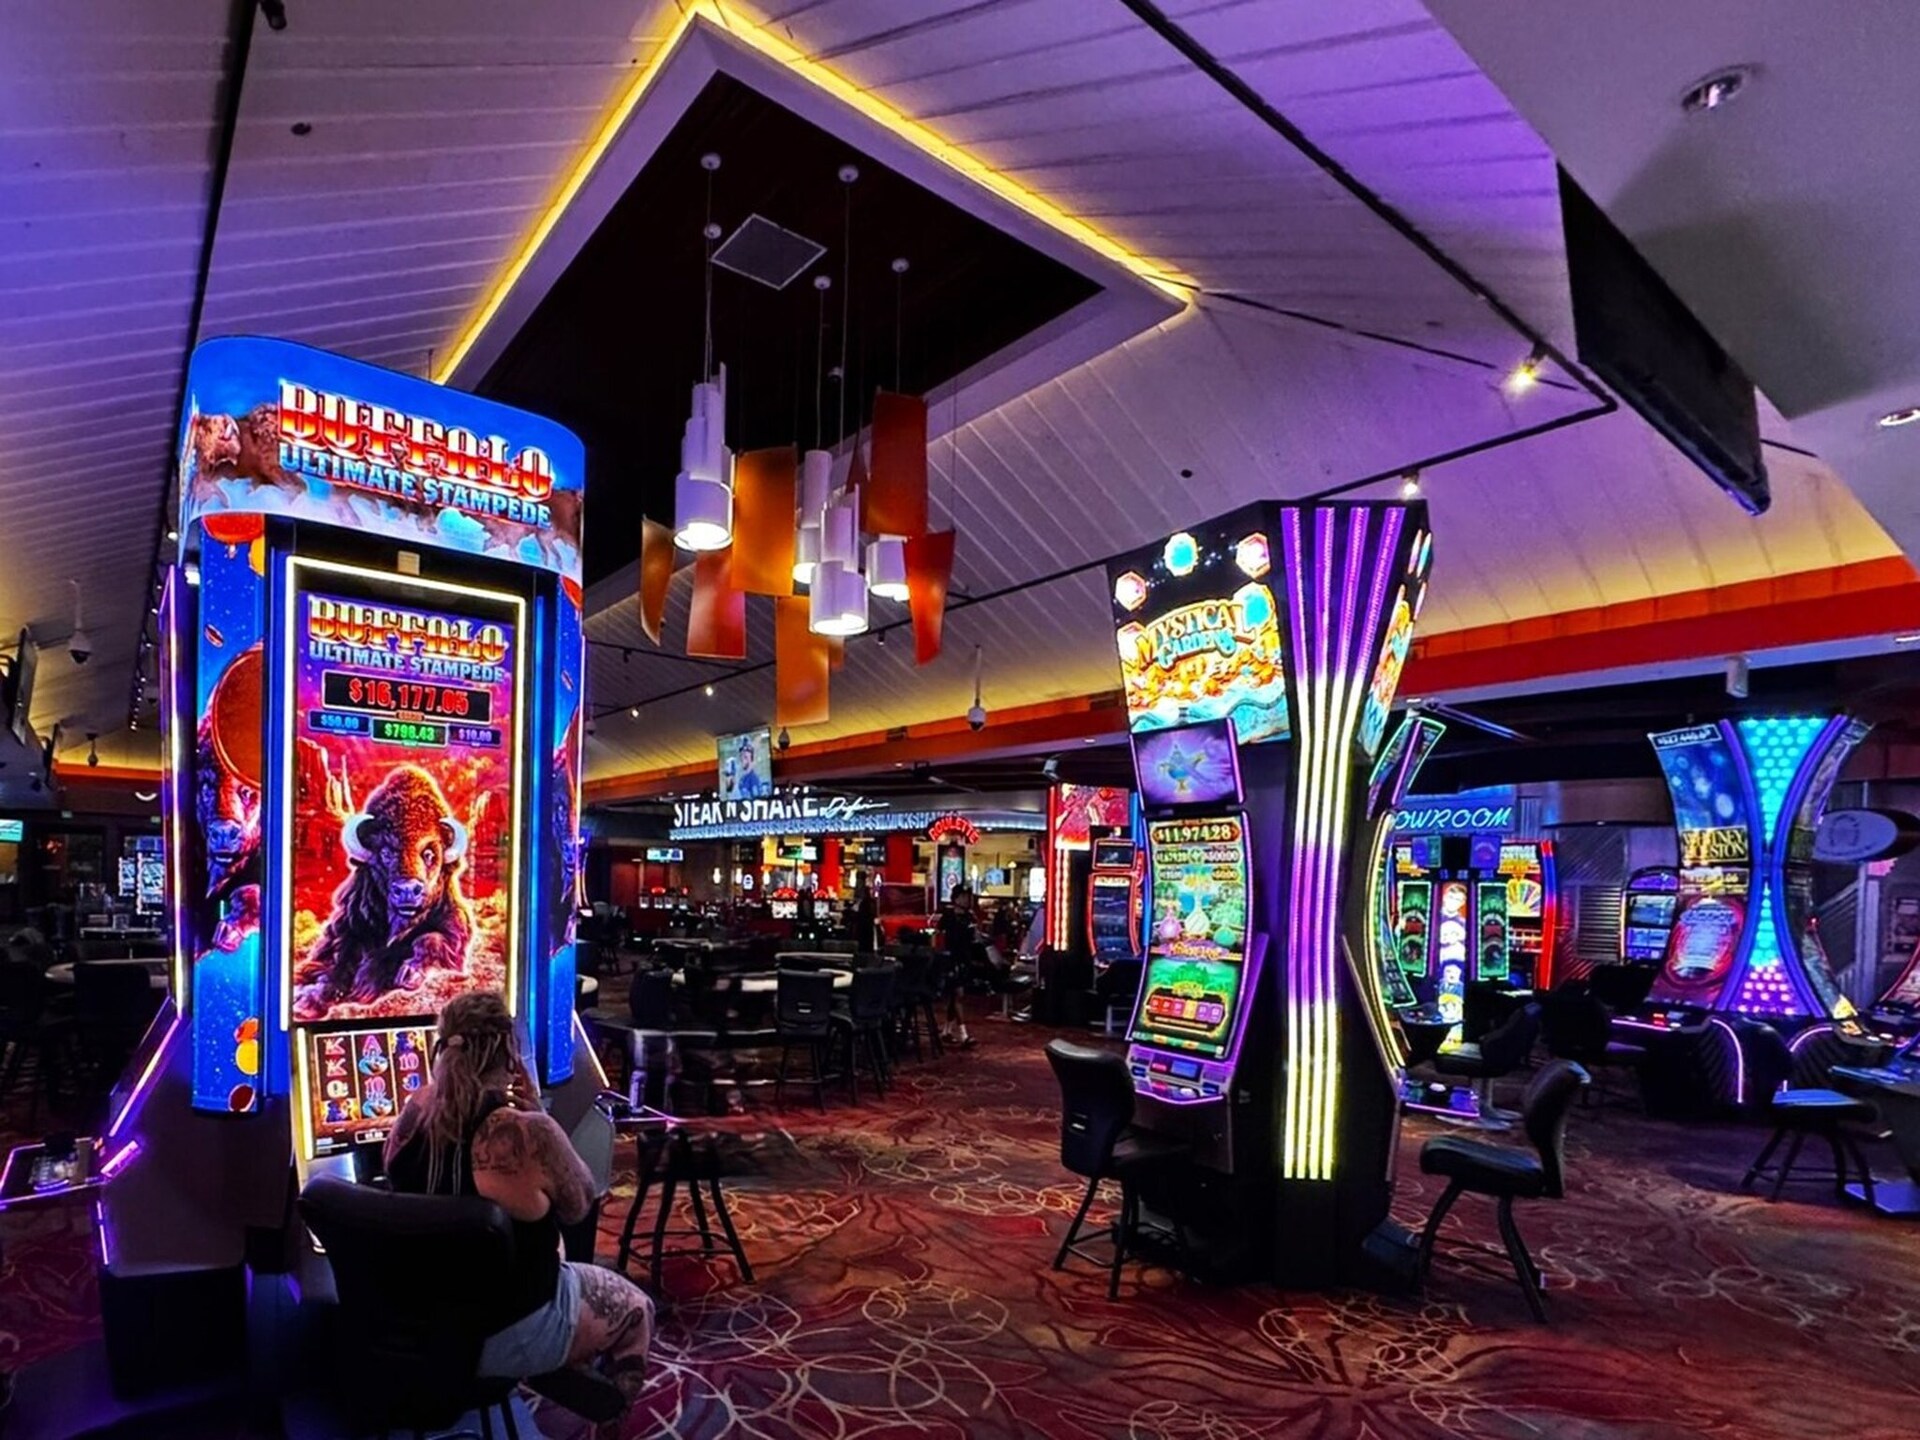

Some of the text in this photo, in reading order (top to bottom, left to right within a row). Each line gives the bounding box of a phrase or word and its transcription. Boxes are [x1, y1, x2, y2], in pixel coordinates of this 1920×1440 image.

[278, 379, 555, 502] BUFFALO
[279, 443, 552, 528] ULTIMATE STAMPEDE
[308, 595, 509, 665] BUFFALO
[1135, 603, 1257, 672] MYSTICAL
[309, 640, 505, 682] ULTIMATE STAMPEDE
[674, 802, 723, 827] STEAK
[740, 798, 818, 821] SHAKE
[1395, 807, 1512, 830] OWROOM
[928, 816, 980, 844] ROULETTE
[323, 1037, 345, 1055] K
[326, 1058, 347, 1077] K
[399, 1053, 419, 1070] 10
